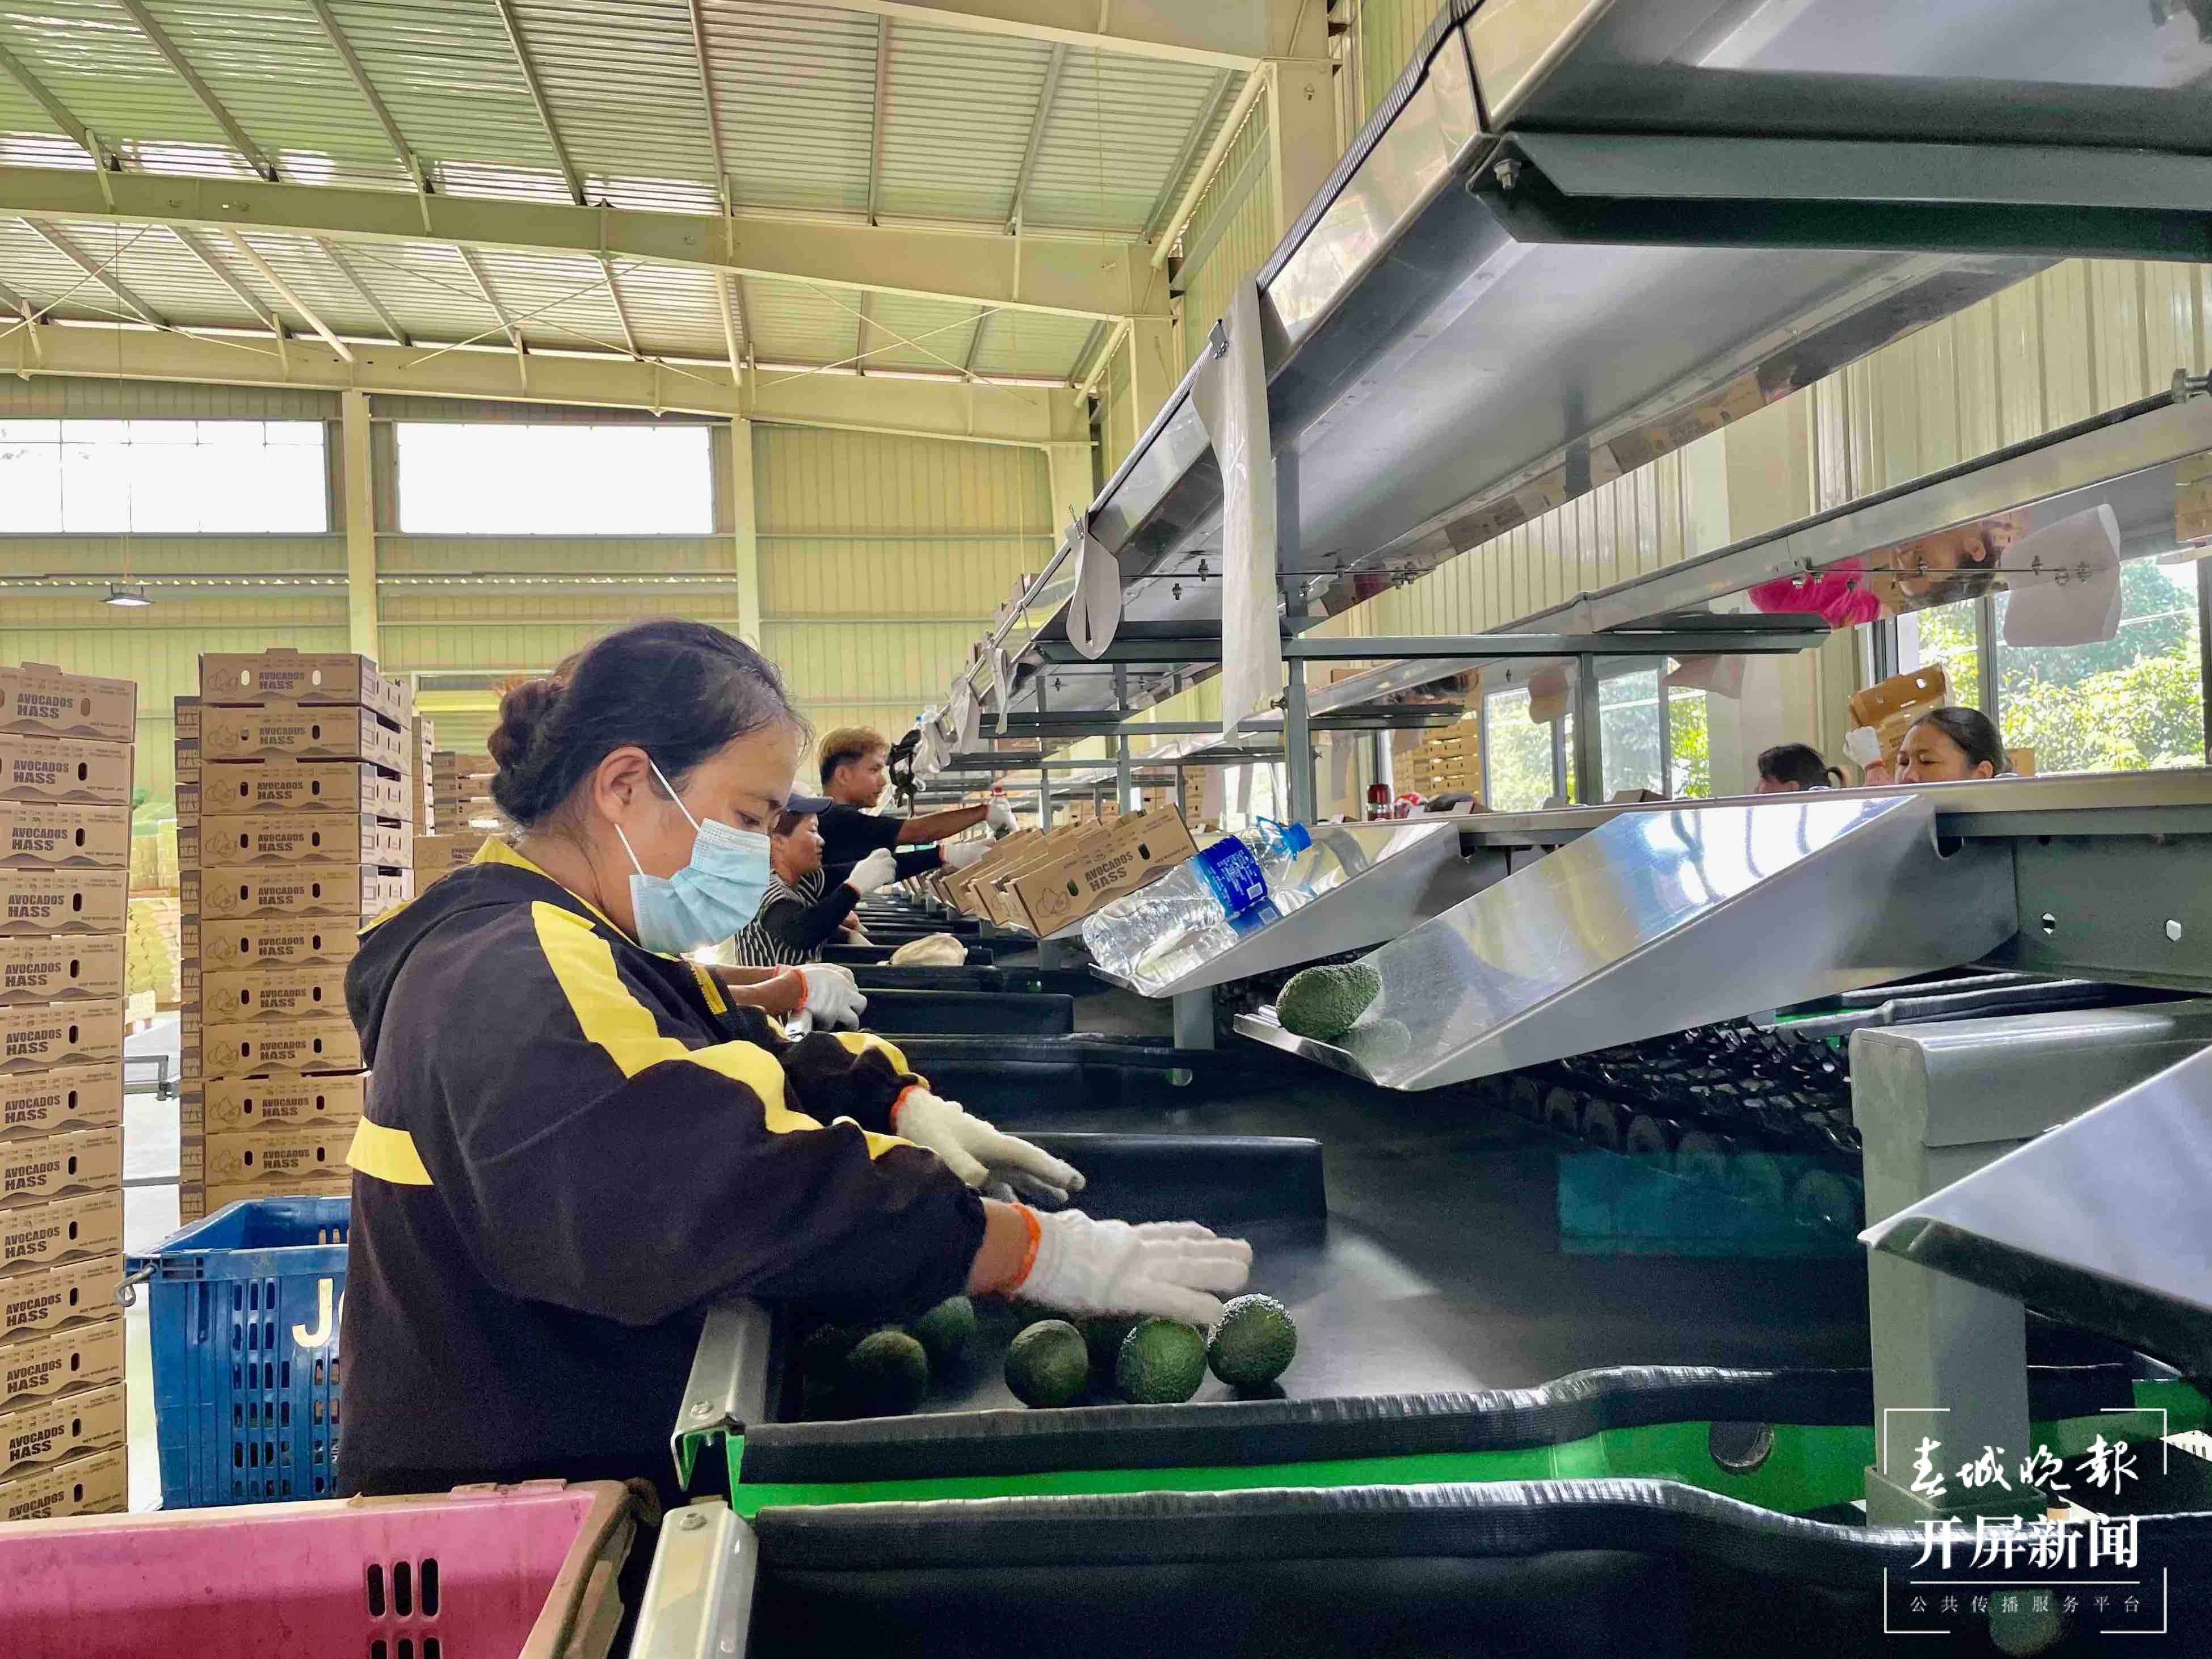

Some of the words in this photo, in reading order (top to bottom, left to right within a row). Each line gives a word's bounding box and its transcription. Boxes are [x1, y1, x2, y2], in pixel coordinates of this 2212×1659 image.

[259, 672, 305, 680] AVOCADOS
[259, 680, 293, 689] HASS
[18, 693, 73, 708] AVOCADOS
[17, 704, 60, 719] HASS
[259, 727, 306, 735] AVOCADOS
[260, 736, 294, 745] HASS
[13, 760, 69, 772] AVOCADOS
[13, 772, 56, 784] HASS
[257, 781, 304, 790] AVOCADOS
[258, 791, 293, 799] HASS
[12, 827, 68, 839] AVOCADOS
[258, 833, 304, 842] AVOCADOS
[12, 839, 54, 850] HASS
[258, 843, 293, 851] HASS
[1084, 852, 1134, 881] AVOCADOS
[1089, 868, 1128, 892] HASS
[258, 886, 305, 895] AVOCADOS
[9, 894, 64, 905] AVOCADOS
[259, 896, 293, 904] HASS
[8, 906, 51, 917] HASS
[258, 937, 305, 946] AVOCADOS
[259, 946, 294, 955] HASS
[5, 962, 61, 975] AVOCADOS
[5, 974, 48, 987] HASS
[260, 988, 306, 998] AVOCADOS
[260, 999, 295, 1008] HASS
[6, 1029, 62, 1043] AVOCADOS
[6, 1042, 48, 1055] HASS
[259, 1041, 306, 1050] AVOCADOS
[260, 1051, 296, 1060] HASS
[5, 1095, 61, 1111] AVOCADOS
[262, 1098, 309, 1108] AVOCADOS
[5, 1109, 47, 1123] HASS
[263, 1107, 298, 1117] HASS
[263, 1149, 309, 1159] AVOCADOS
[5, 1161, 60, 1178] AVOCADOS
[263, 1159, 299, 1168] HASS
[5, 1174, 47, 1190] HASS
[5, 1227, 60, 1246] AVOCADOS
[5, 1241, 47, 1258] HASS
[6, 1294, 61, 1315] AVOCADOS
[6, 1308, 48, 1327] HASS
[292, 1278, 346, 1348] J
[7, 1359, 62, 1381] AVOCADOS
[7, 1374, 49, 1393] HASS
[9, 1425, 65, 1450] AVOCADOS
[10, 1441, 52, 1462] HASS
[9, 1491, 65, 1518] AVOCADOS
